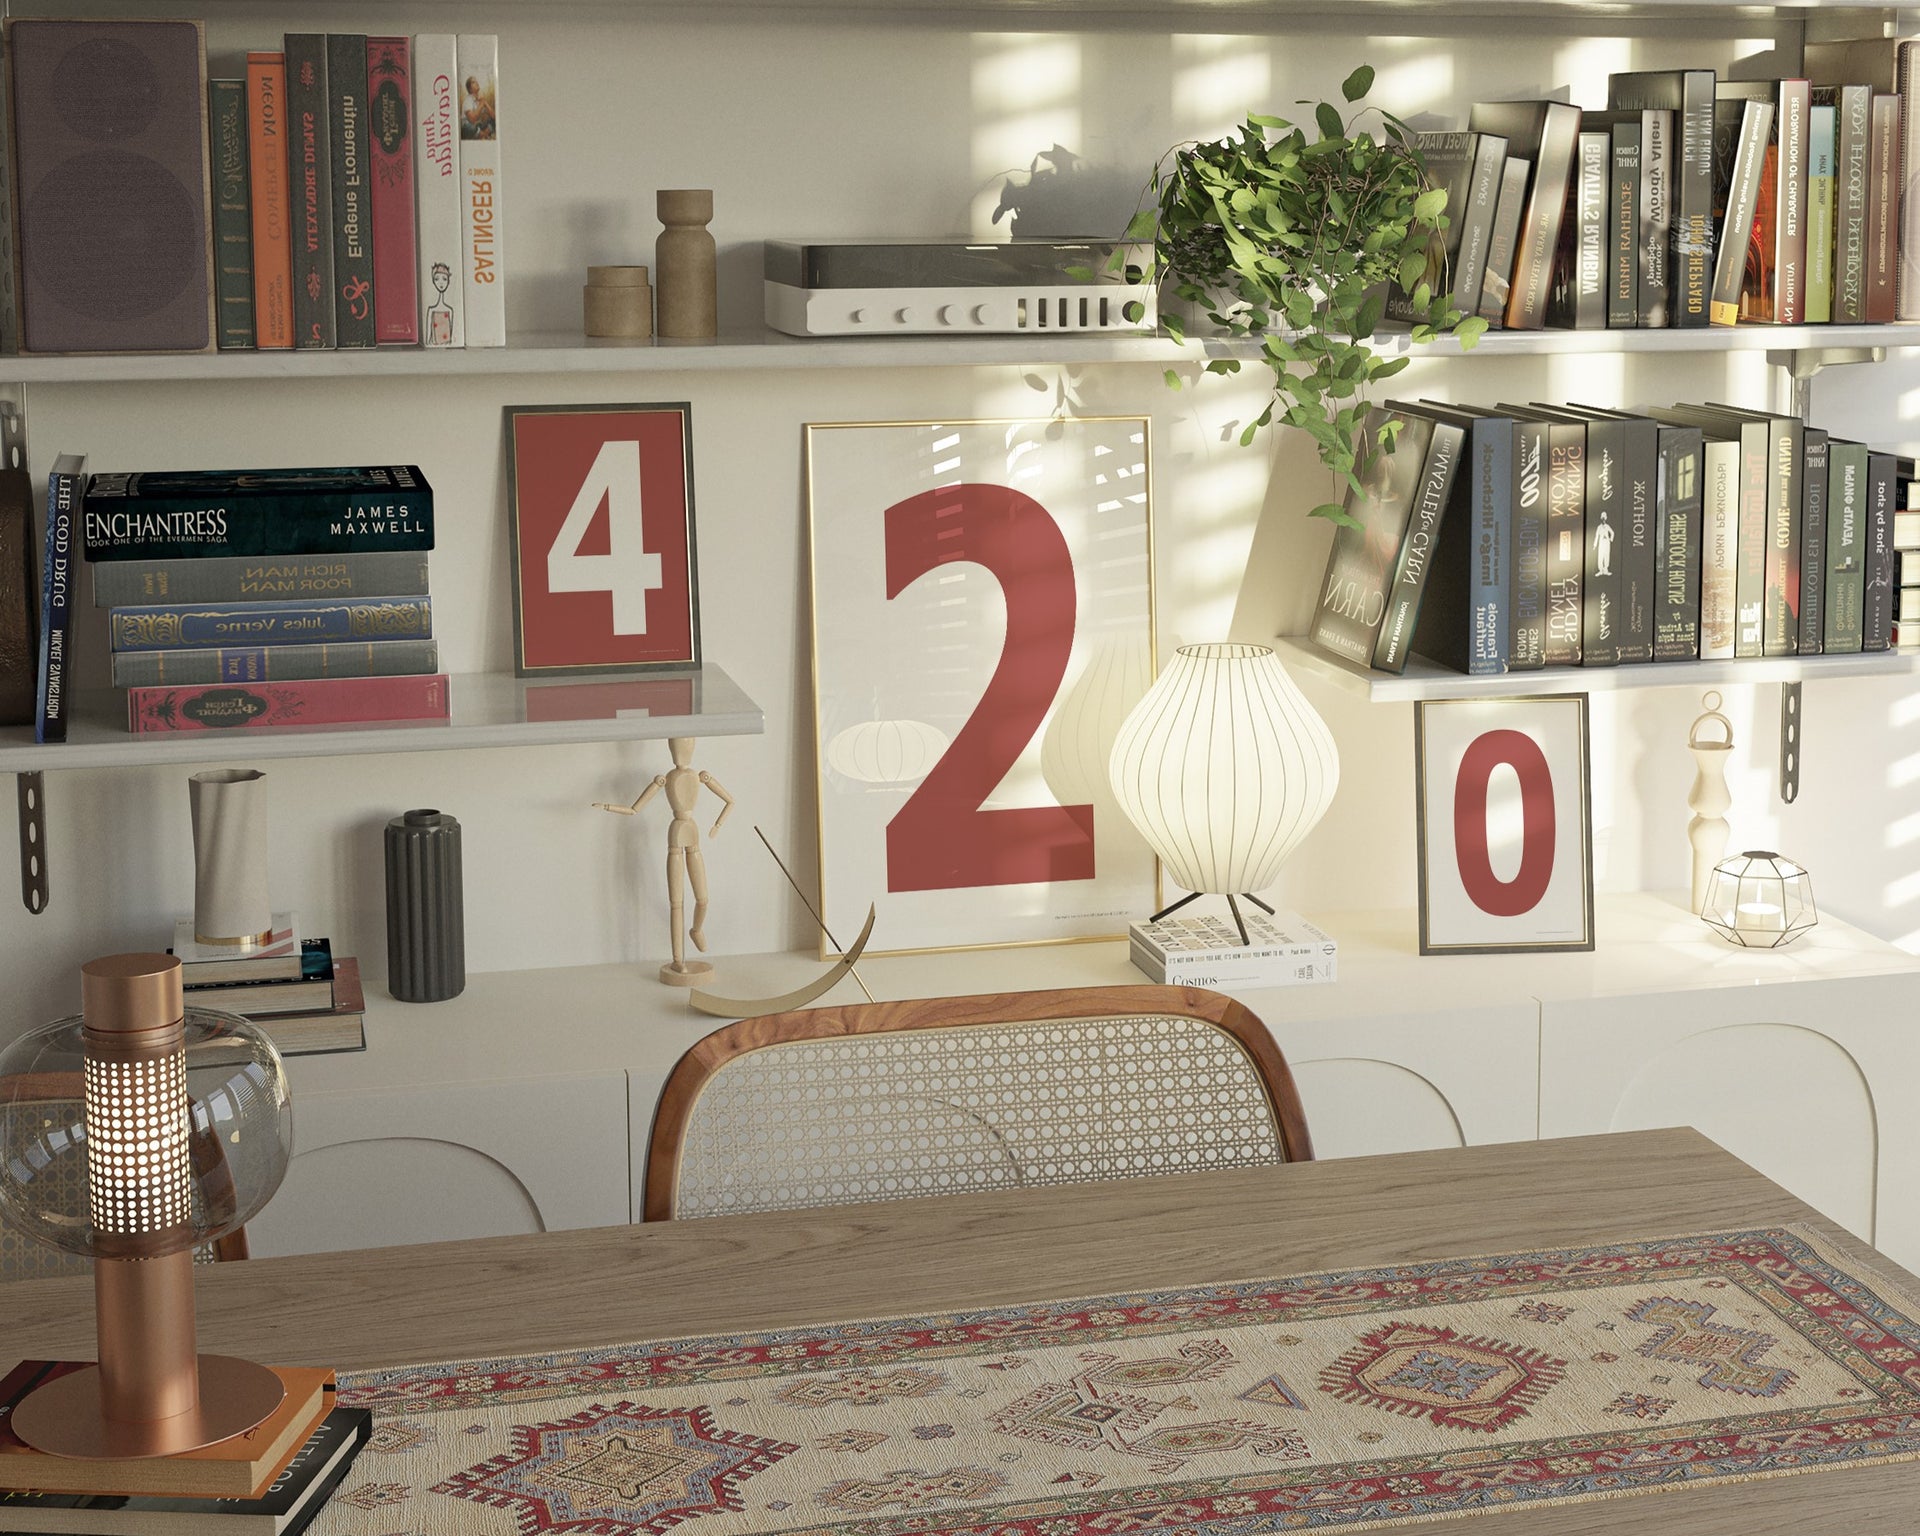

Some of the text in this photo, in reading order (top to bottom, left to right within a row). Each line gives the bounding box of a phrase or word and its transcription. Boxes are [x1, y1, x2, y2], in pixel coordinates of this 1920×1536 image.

[344, 505, 409, 519] JAMES
[86, 508, 227, 540] ENCHANTRESS
[330, 520, 425, 535] MAXWELL
[113, 537, 131, 546] ONE
[134, 536, 145, 545] OF
[149, 535, 163, 543] THE
[167, 535, 203, 543] EVERMEN
[206, 535, 227, 544] SAGA
[547, 440, 663, 636] 4
[884, 482, 1096, 894] 2
[1454, 728, 1556, 917] 0
[1172, 974, 1218, 987] Cosmos
